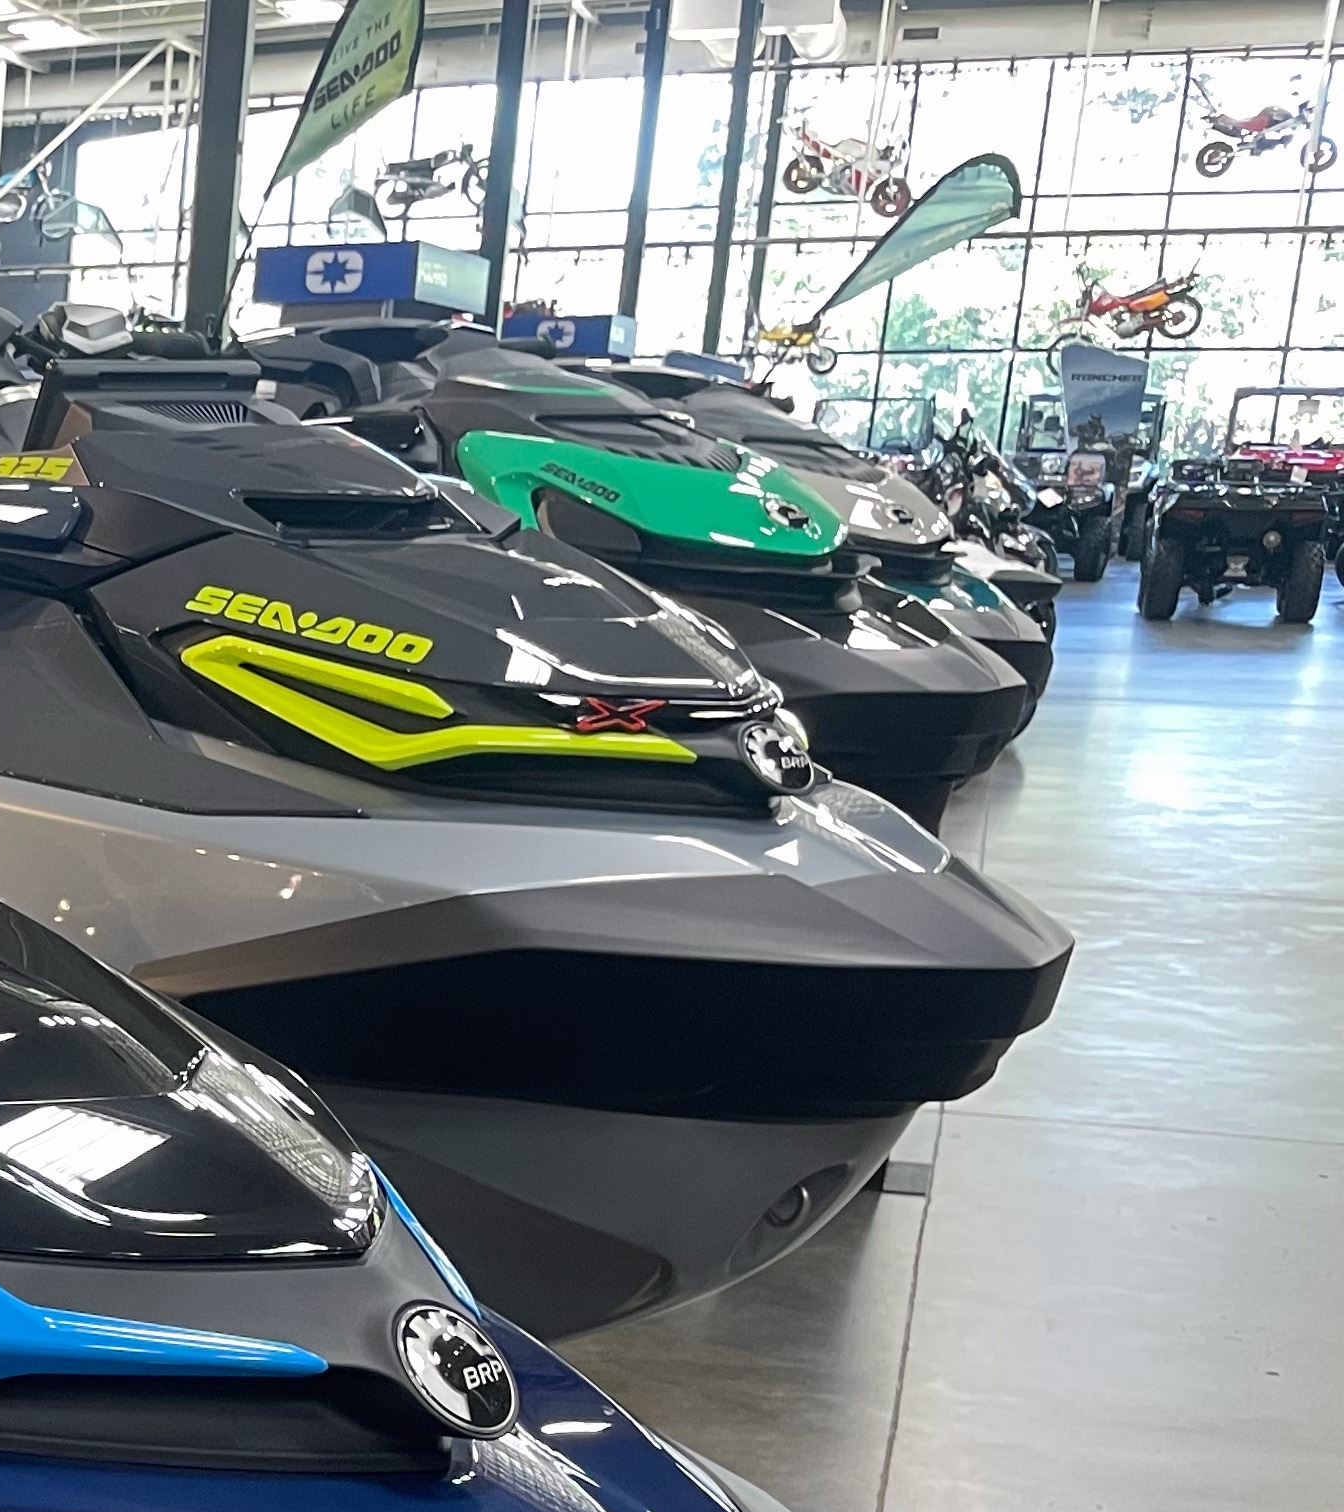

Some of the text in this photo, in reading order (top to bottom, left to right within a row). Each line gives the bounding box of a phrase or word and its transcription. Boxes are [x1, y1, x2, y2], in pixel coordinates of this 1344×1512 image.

[367, 12, 390, 40] THE
[331, 84, 376, 130] LIFE
[463, 1360, 503, 1390] BRP
